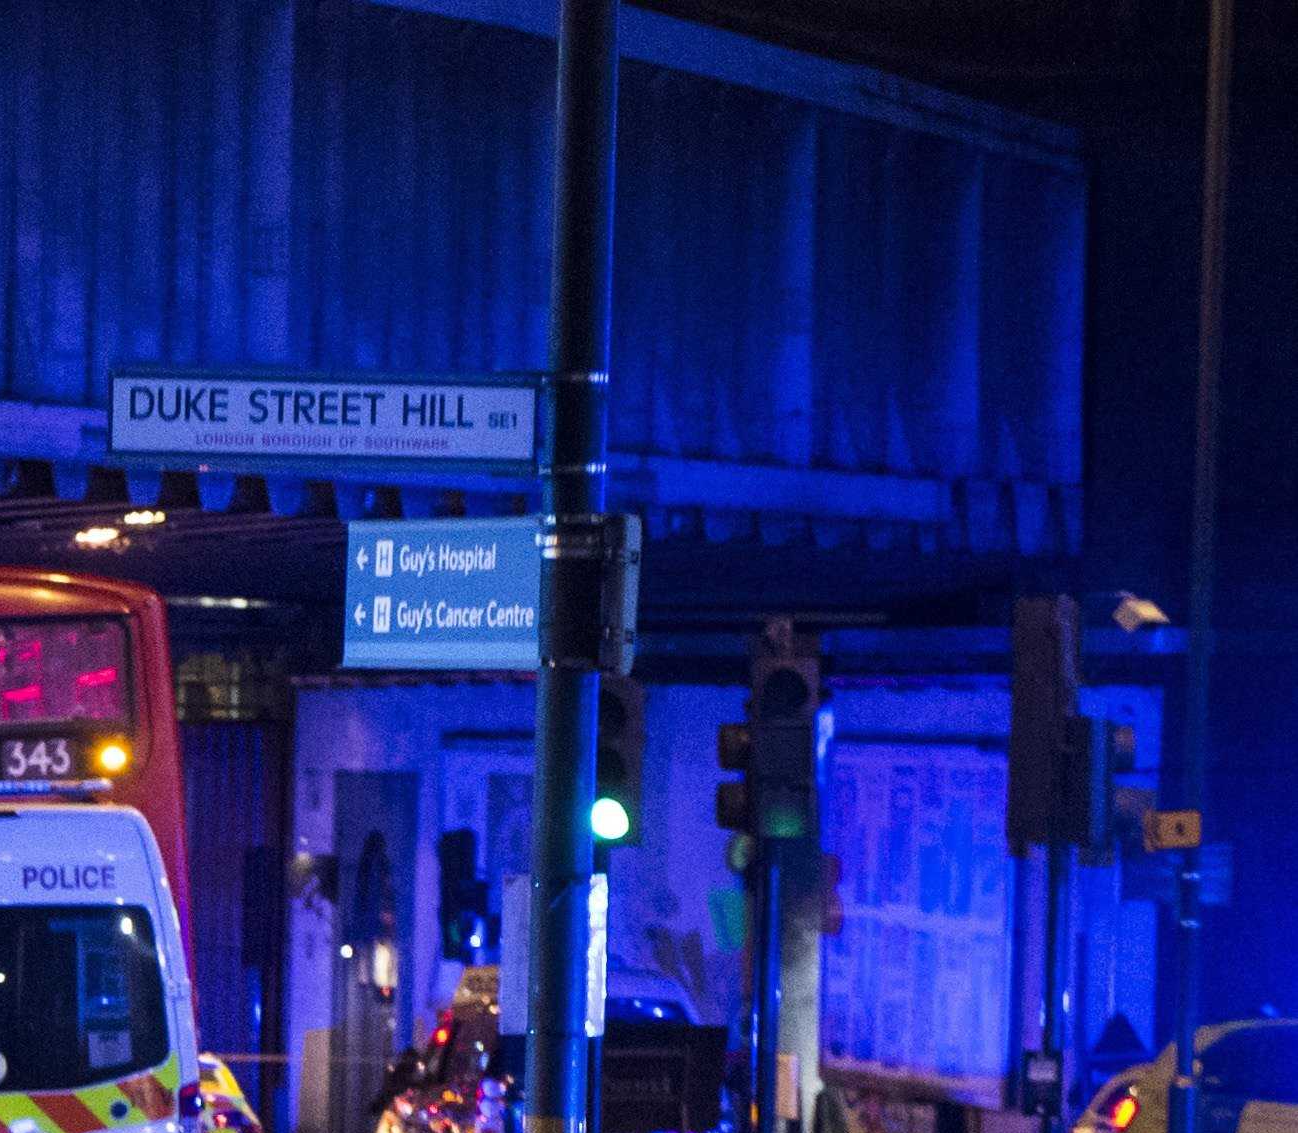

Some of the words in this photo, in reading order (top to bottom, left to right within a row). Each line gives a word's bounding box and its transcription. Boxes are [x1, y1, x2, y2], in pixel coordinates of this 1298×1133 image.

[129, 385, 229, 424] DUKE
[249, 388, 386, 427] STREET
[401, 392, 474, 429] HILL
[487, 410, 518, 429] SE1
[195, 432, 255, 447] LONDON
[261, 433, 332, 448] BOROUGH
[338, 435, 358, 449] OF
[363, 435, 450, 451] SOUTHWARK
[399, 543, 435, 577] Guy's
[438, 542, 497, 576] Hospital
[396, 600, 433, 634] Guy's
[435, 600, 485, 628] Cancer
[486, 599, 535, 628] Centre
[6, 738, 71, 777] 343
[21, 864, 116, 892] POLICE
